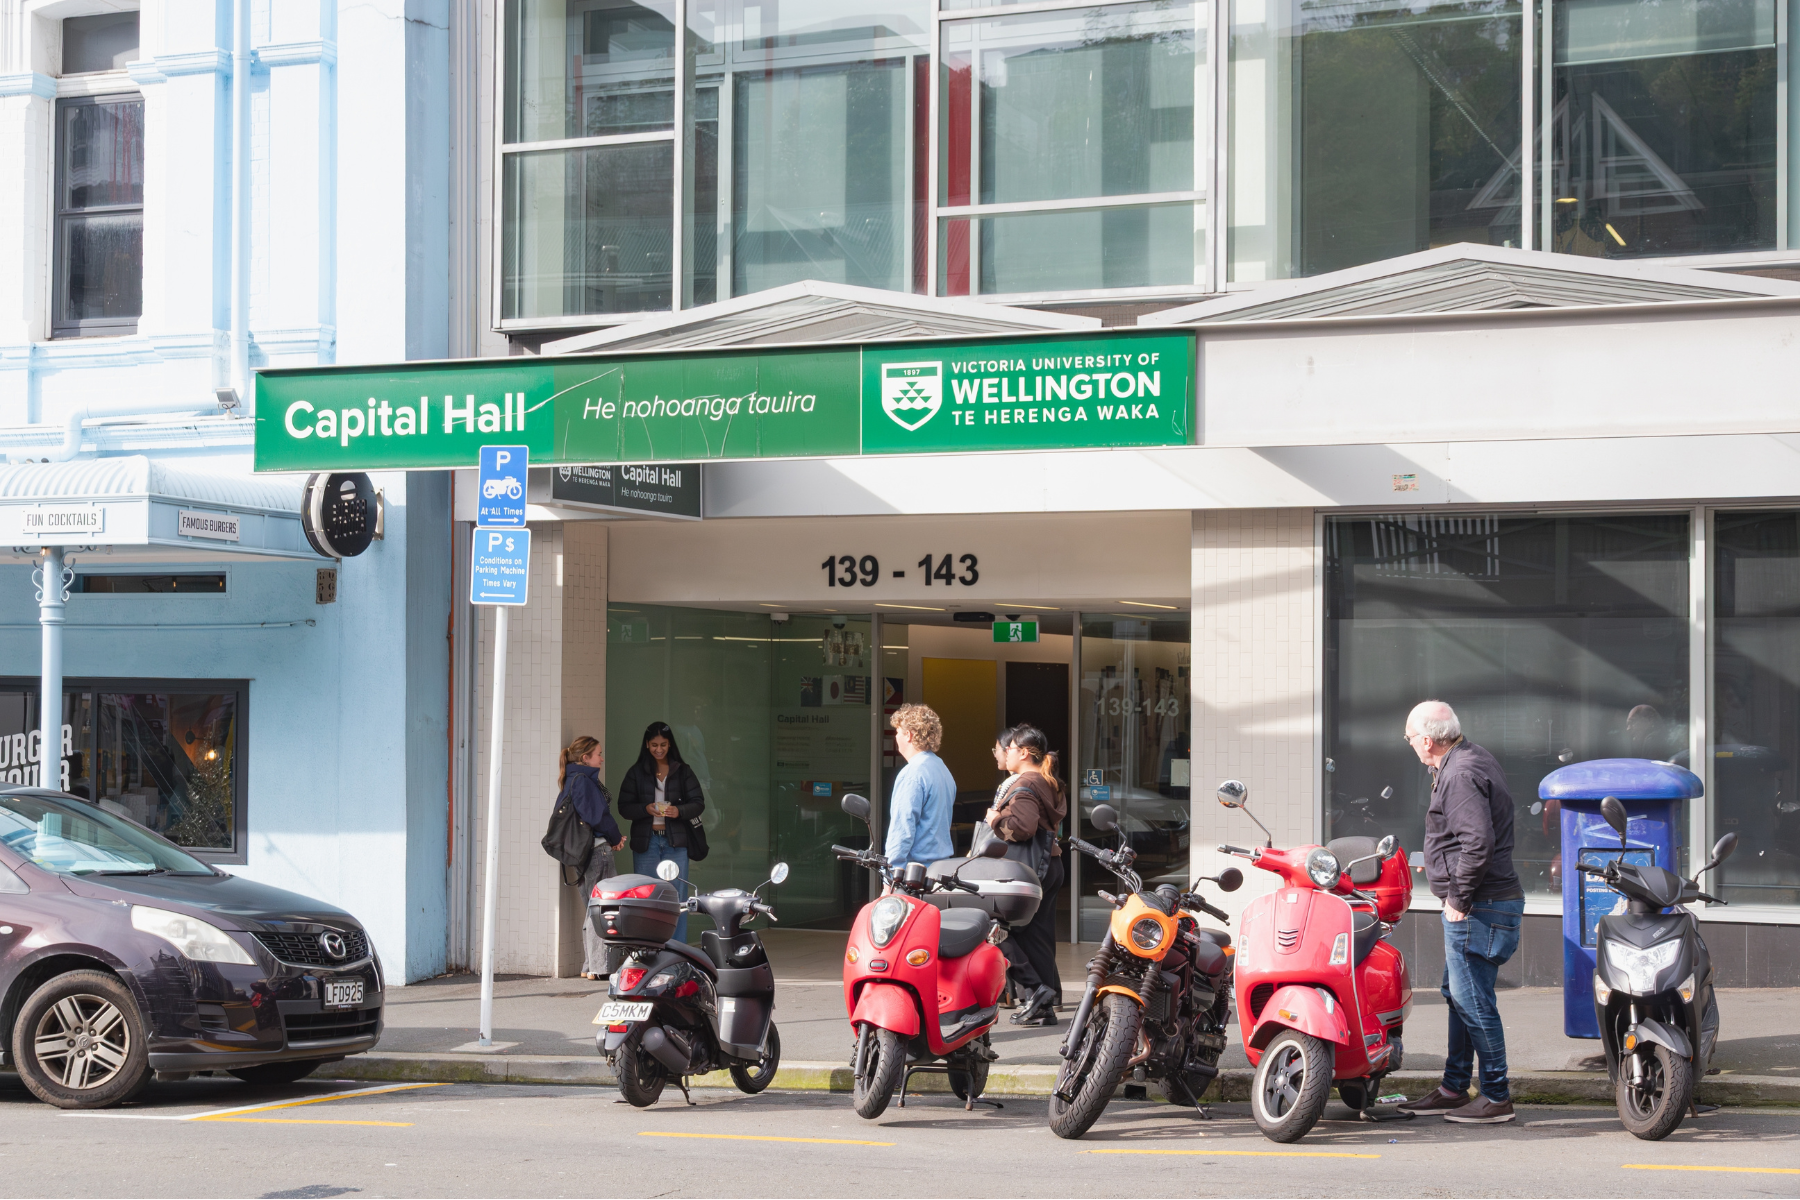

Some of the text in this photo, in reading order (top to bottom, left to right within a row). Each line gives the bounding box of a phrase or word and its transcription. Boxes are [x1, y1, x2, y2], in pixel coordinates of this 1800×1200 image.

[903, 368, 921, 376] 1897
[952, 352, 1160, 374] VICTORIA UNIVERSITY OF
[951, 370, 1161, 405] WELLINGTON
[583, 390, 816, 421] He nohoanga tauira
[952, 403, 1160, 426] TE HERENGA WAKA
[284, 392, 525, 447] Capital Hall
[496, 451, 511, 471] P
[572, 466, 611, 480] WELLINGTON
[578, 476, 599, 486] HERENGA
[621, 465, 682, 488] Capital Hall
[621, 486, 630, 497] He
[630, 489, 657, 502] nohoanga
[26, 512, 97, 526] FUN COCKTAILS
[480, 507, 523, 516] At All Times
[182, 516, 237, 534] FAMOUS BURGERS
[488, 532, 503, 553] P
[479, 556, 512, 565] Conditions
[475, 565, 526, 576] Parking Machine
[821, 554, 880, 588] 139
[917, 553, 980, 587] 143
[482, 578, 517, 589] Times Vary
[1096, 697, 1180, 717] 139-143
[777, 714, 830, 725] Capital Hall
[0, 723, 73, 769] URGR
[325, 985, 363, 1003] LFD925
[602, 1004, 648, 1018] C5MKM
